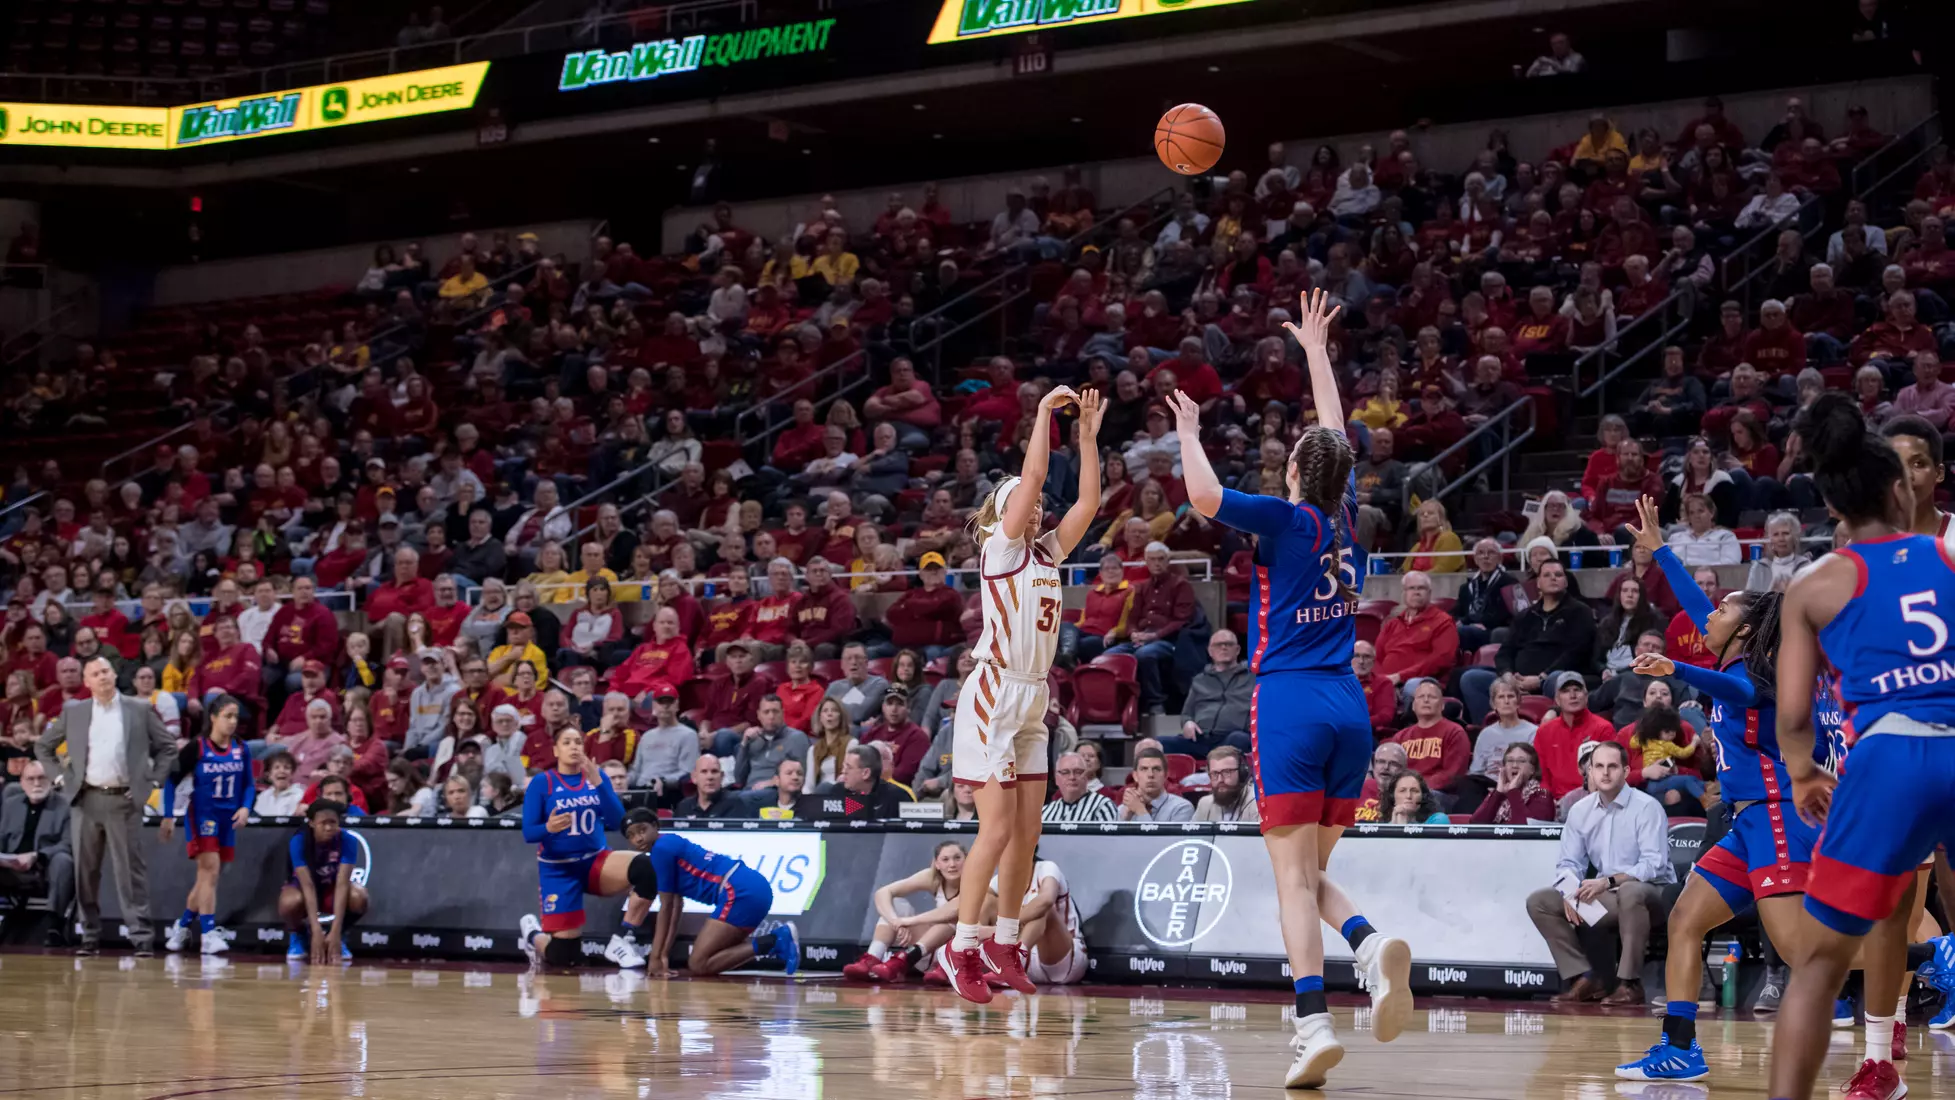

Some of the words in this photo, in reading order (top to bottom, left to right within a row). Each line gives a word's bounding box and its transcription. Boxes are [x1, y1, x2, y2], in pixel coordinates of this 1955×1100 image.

[702, 18, 837, 67] EQUIPMENT
[1018, 52, 1046, 73] 110
[356, 91, 403, 111] JOHN
[407, 81, 465, 103] DEERE
[19, 116, 82, 134] JOHN
[88, 117, 164, 138] DEERE
[1519, 324, 1550, 338] ISU
[1900, 589, 1948, 657] 5
[203, 762, 244, 773] KANSAS
[212, 774, 235, 798] 11
[567, 808, 596, 836] 10
[1141, 882, 1226, 902] BAYER
[1166, 847, 1199, 939] BAYER
[1130, 957, 1164, 974] HyVee
[1210, 958, 1247, 975] HyVee
[1428, 966, 1467, 984] HyVee
[1504, 969, 1544, 987] HyVee
